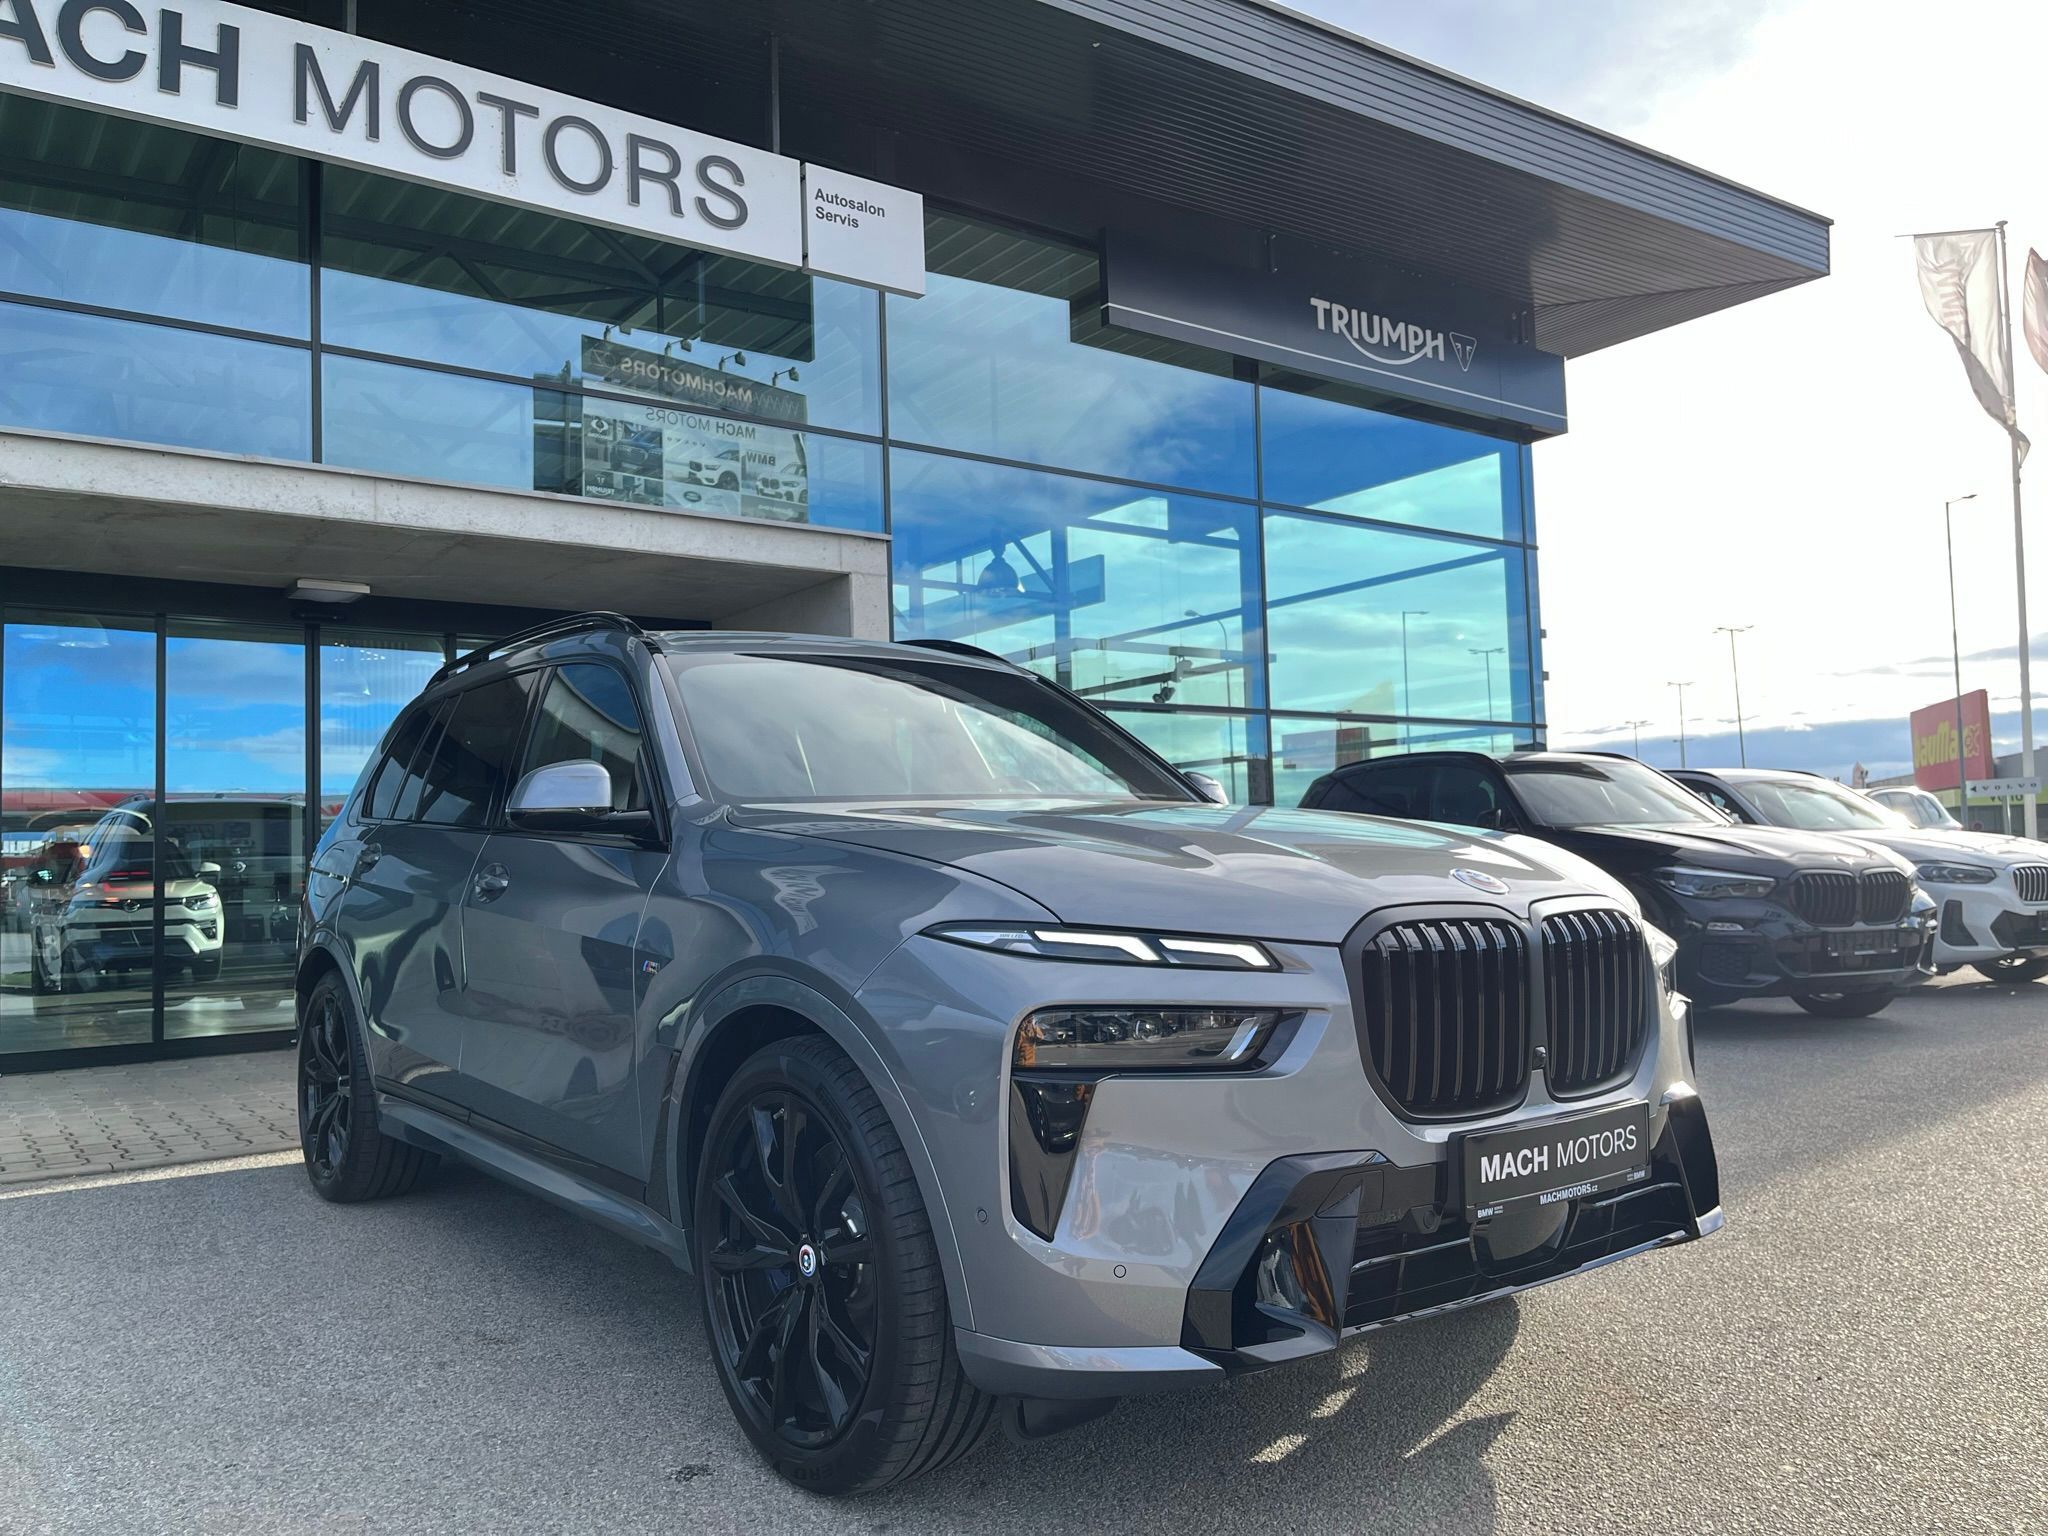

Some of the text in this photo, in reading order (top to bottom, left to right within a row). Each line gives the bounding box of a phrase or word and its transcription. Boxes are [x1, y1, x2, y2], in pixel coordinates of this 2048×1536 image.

[294, 42, 749, 231] MOTORS
[815, 188, 885, 218] Autosalon
[815, 206, 859, 228] Servis
[1310, 297, 1445, 364] TRIUMPH
[1982, 782, 2037, 791] VOLVO
[1480, 1125, 1637, 1183] MACH MOTORS
[1540, 1184, 1599, 1205] MACHMOTORS.cz
[1477, 1207, 1494, 1219] BMW
